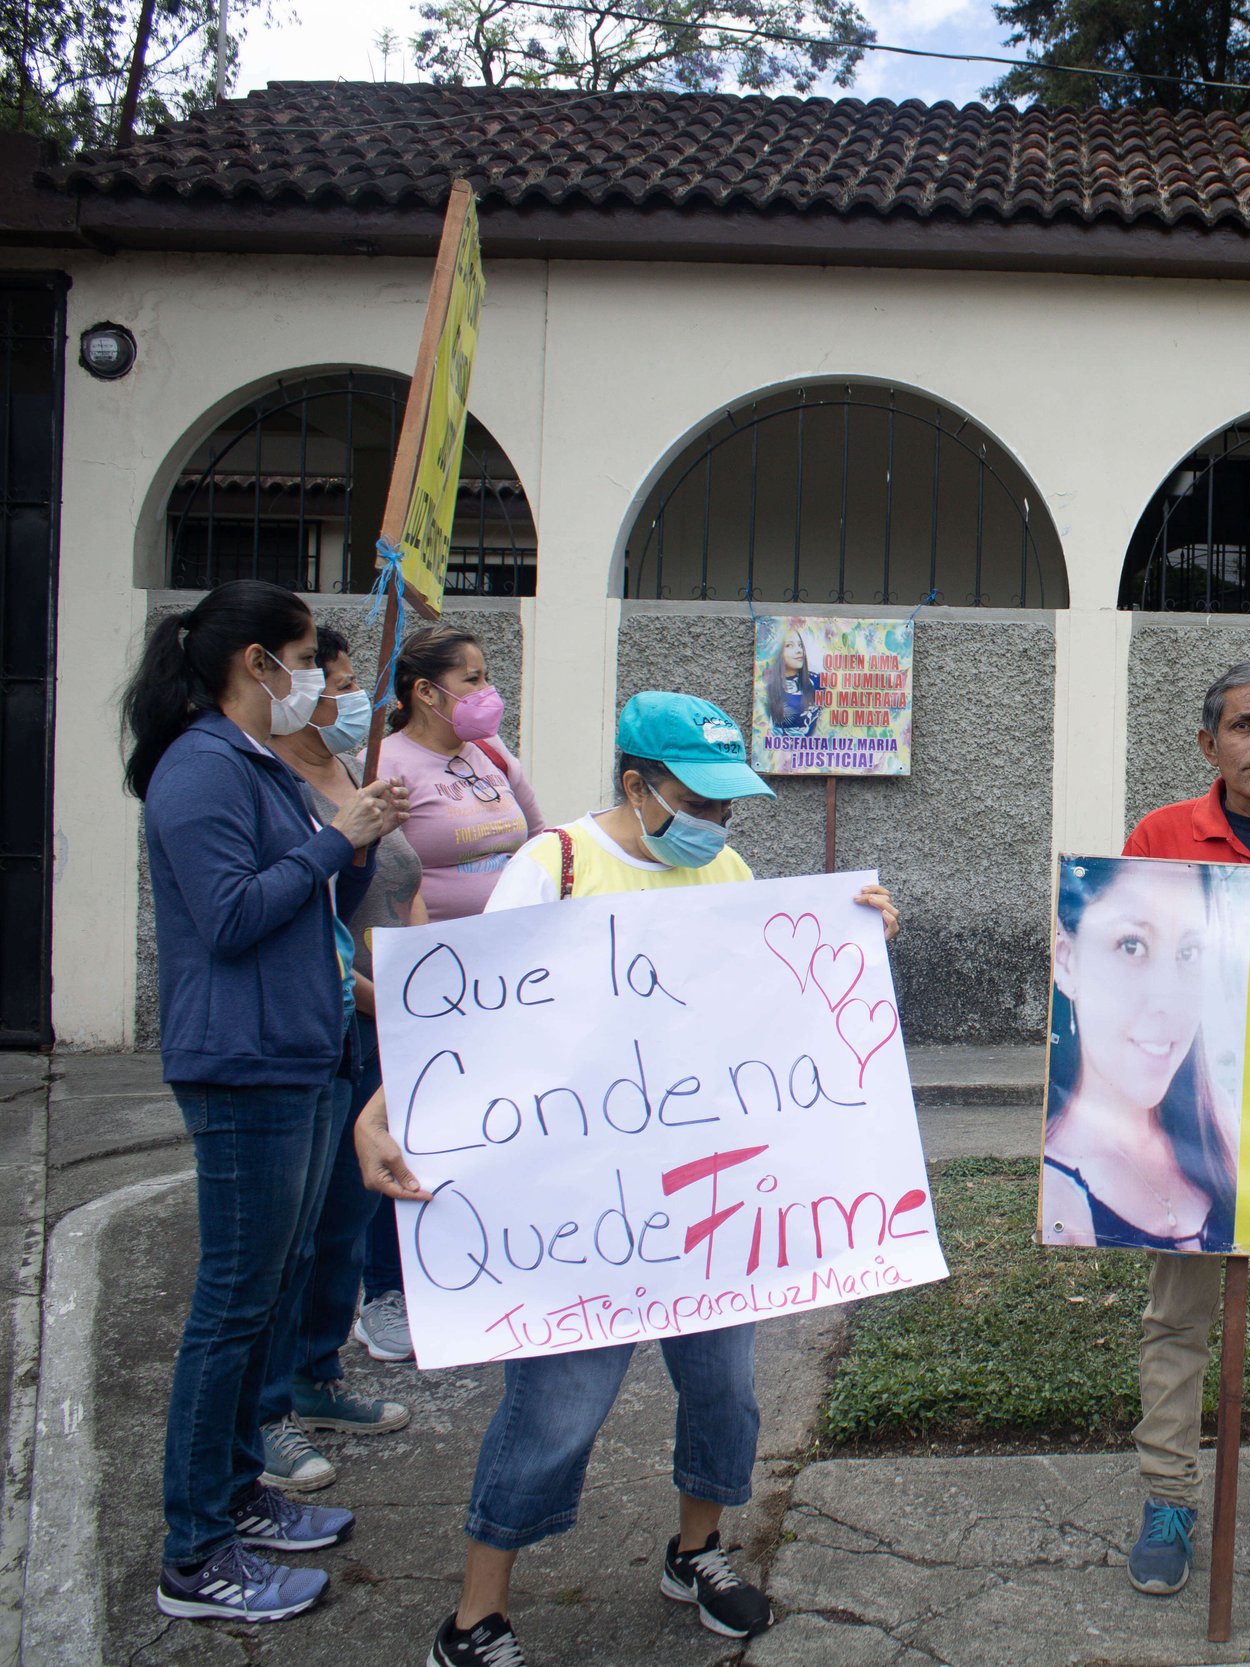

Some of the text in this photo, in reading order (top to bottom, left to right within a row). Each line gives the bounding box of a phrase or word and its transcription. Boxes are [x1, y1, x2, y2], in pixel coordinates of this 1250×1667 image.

[823, 653, 899, 671] QUIEN AMA
[819, 672, 903, 689] NO HUMILLA
[814, 690, 907, 708] NO MALTRATA
[830, 709, 890, 727] NO MATA
[764, 736, 898, 751] NOS FALTA LUZ MARIA
[791, 752, 874, 769] ¡JUSTICIA!
[402, 914, 687, 1019] Que la
[404, 1039, 867, 1156] Condena
